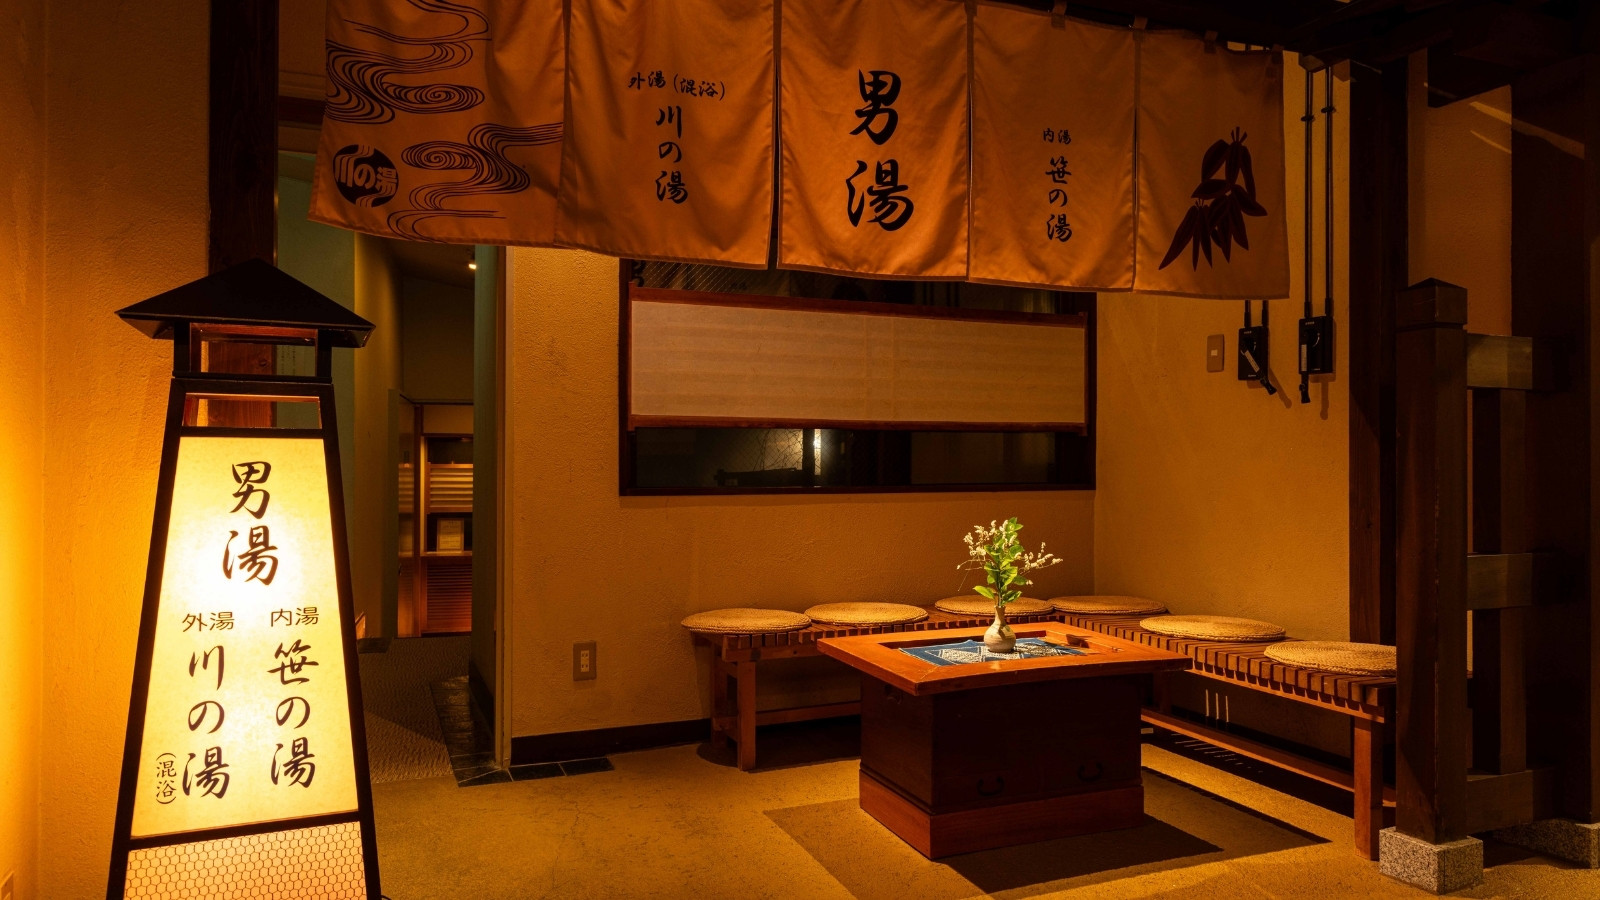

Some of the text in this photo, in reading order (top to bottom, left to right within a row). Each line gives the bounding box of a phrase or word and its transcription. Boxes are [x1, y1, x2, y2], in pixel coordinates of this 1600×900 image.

[334, 154, 399, 196] 川の湯
[655, 105, 689, 205] 川の湯
[845, 69, 914, 232] 男湯
[1043, 127, 1072, 146] 内湯
[1045, 156, 1073, 243] 笹の湯
[222, 461, 279, 586] 男湯
[182, 611, 235, 632] 外湯
[270, 606, 320, 628] 内湯
[182, 645, 231, 799] 川の湯
[267, 638, 320, 788] 笹の湯
[156, 752, 177, 805] （混浴）
